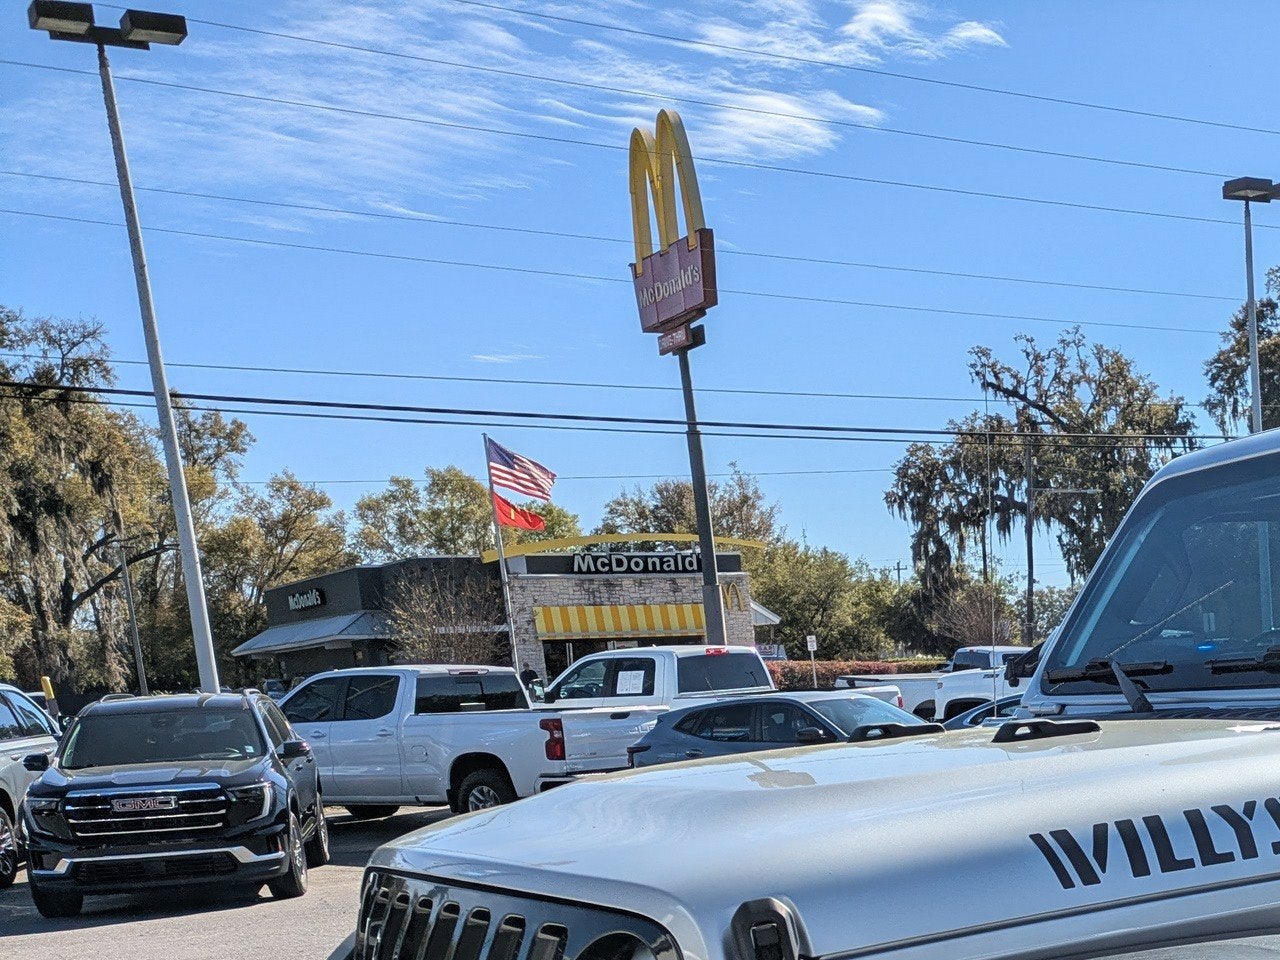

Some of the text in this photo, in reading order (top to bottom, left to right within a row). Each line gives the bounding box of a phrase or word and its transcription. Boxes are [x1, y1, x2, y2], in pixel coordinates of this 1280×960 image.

[638, 263, 701, 309] McDonald's
[573, 553, 702, 573] McDonald'
[117, 798, 173, 811] GMC
